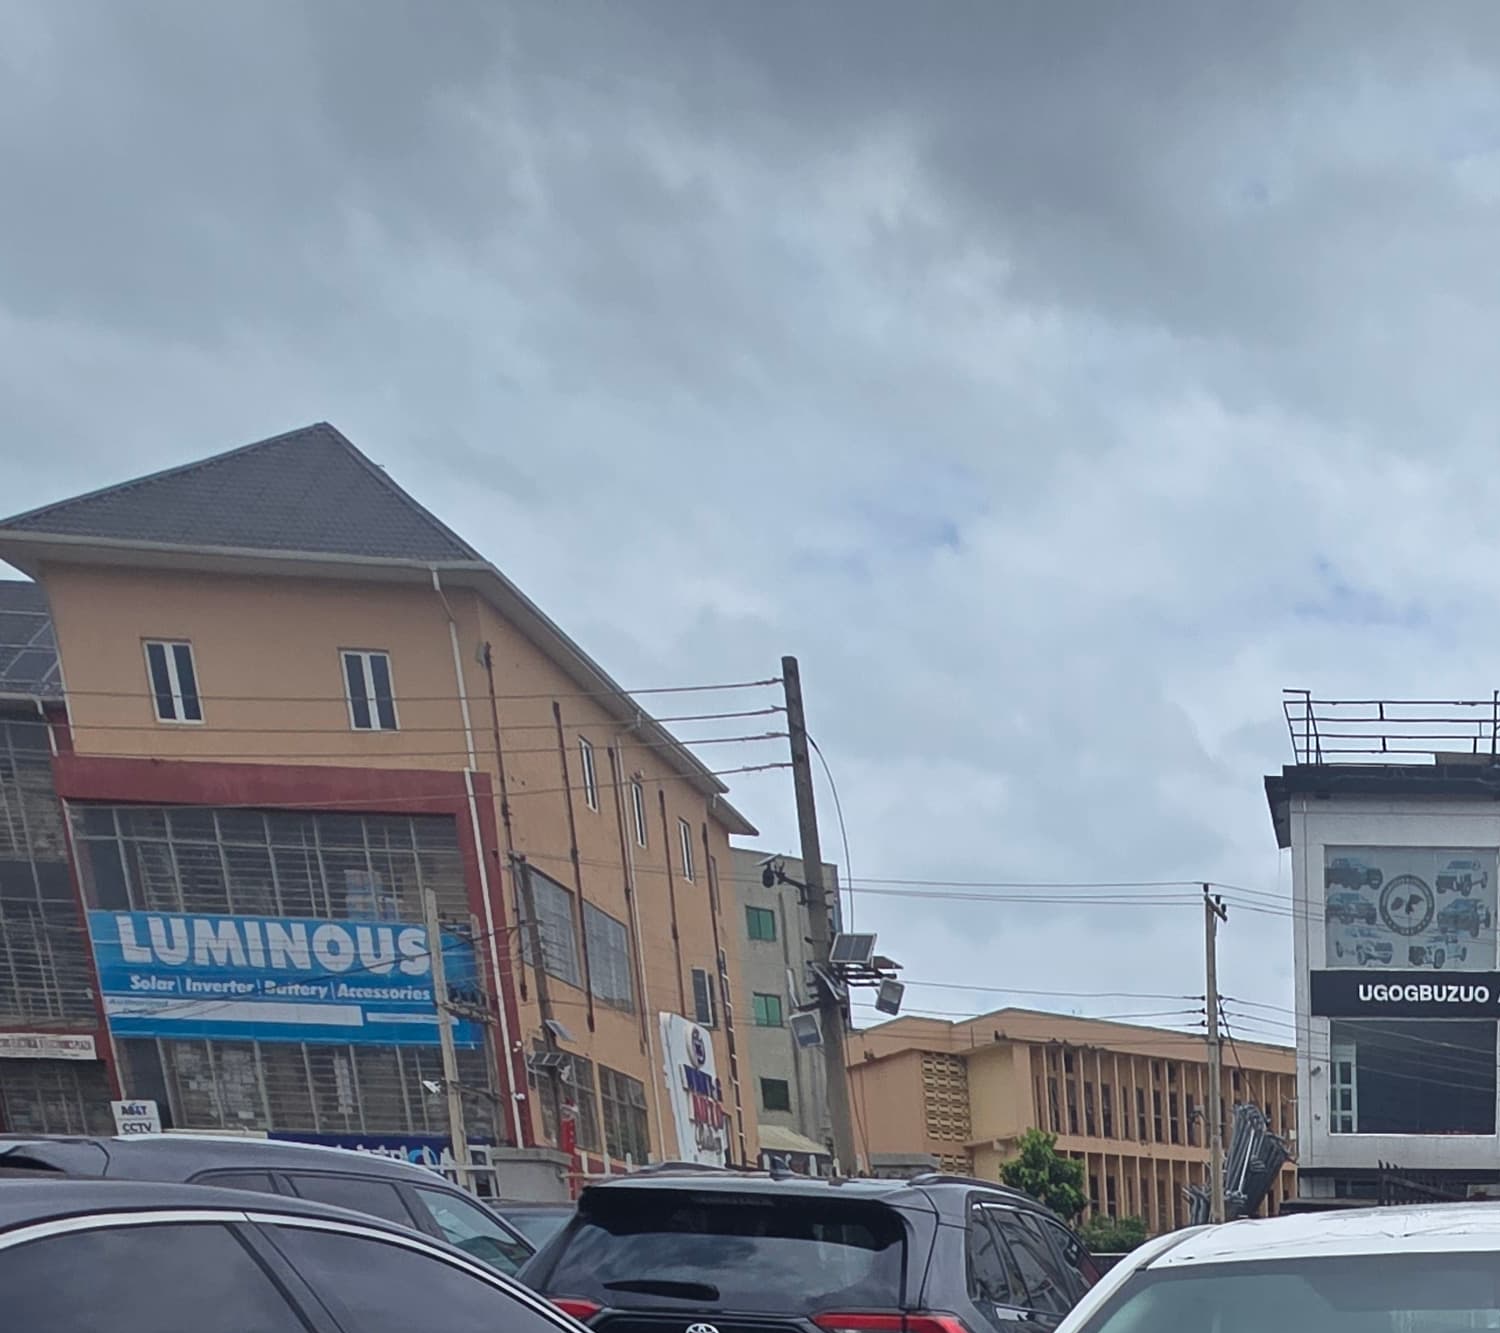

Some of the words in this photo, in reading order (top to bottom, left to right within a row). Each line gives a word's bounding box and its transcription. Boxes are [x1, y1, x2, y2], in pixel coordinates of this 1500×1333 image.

[116, 915, 430, 976] LUMINOUS
[130, 974, 175, 991] Solar
[185, 978, 255, 994] Inverter
[264, 980, 328, 999] Battery
[338, 983, 430, 1000] Accessories
[1358, 984, 1489, 1003] UGOGBUZUO
[122, 1121, 152, 1134] CCTV
